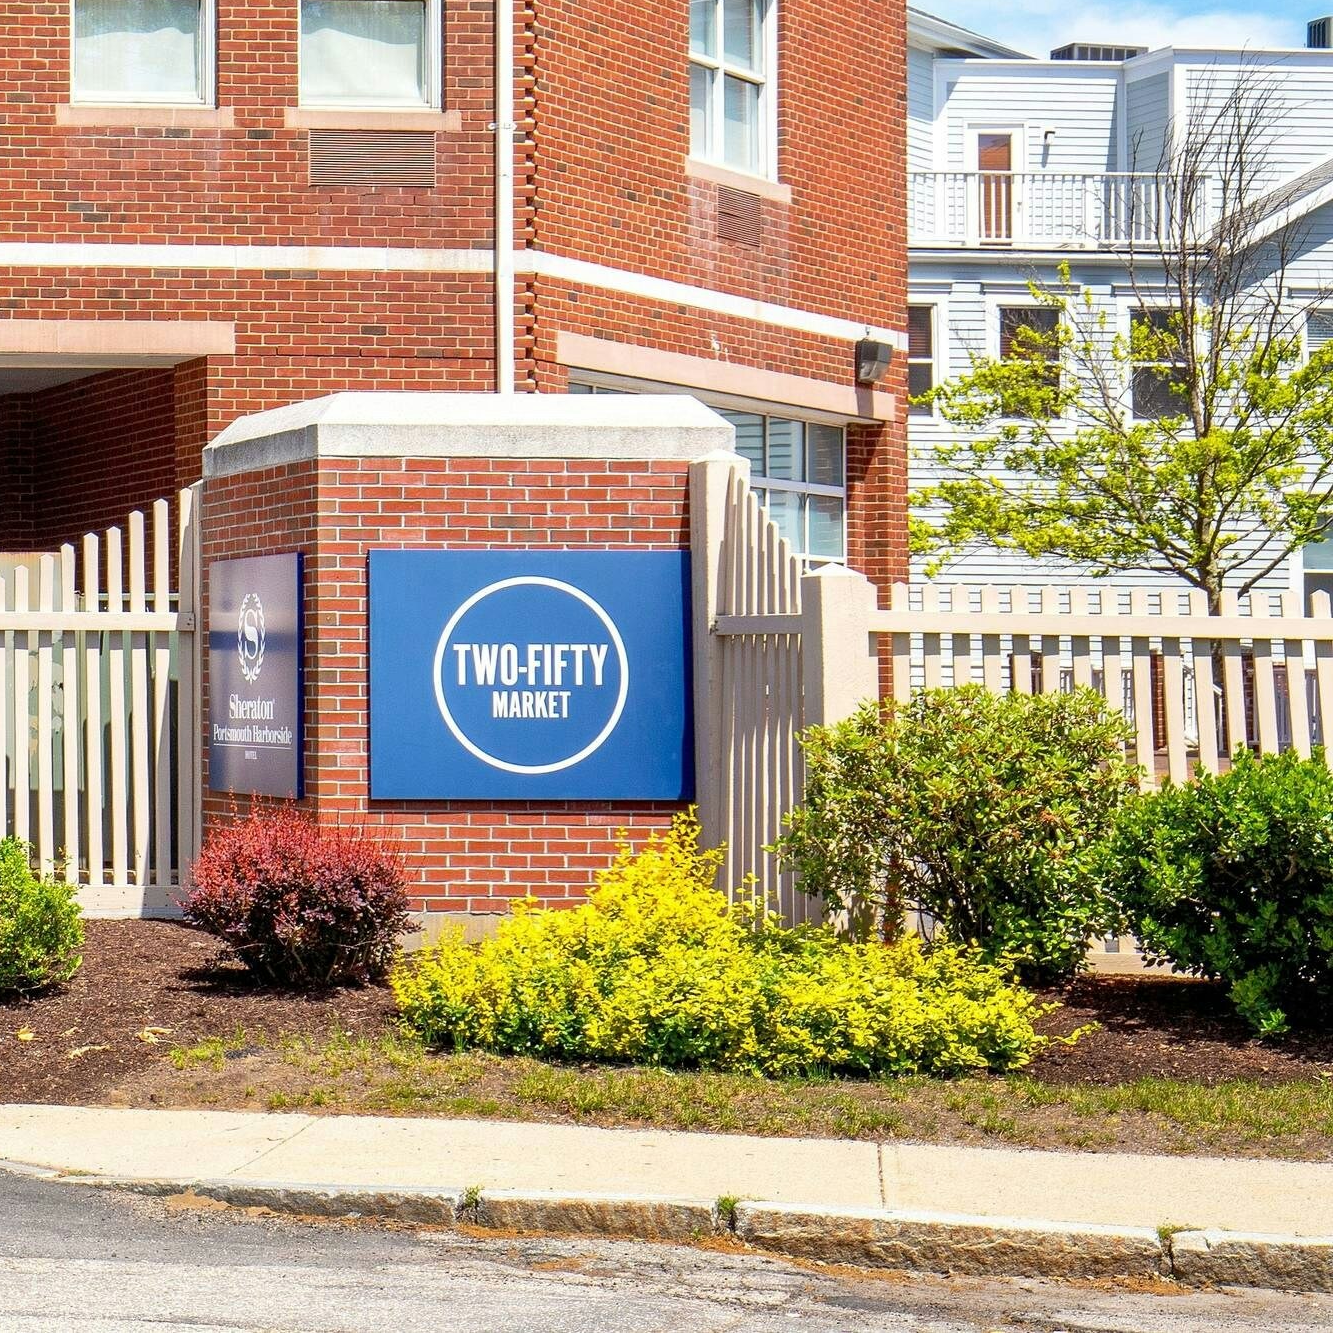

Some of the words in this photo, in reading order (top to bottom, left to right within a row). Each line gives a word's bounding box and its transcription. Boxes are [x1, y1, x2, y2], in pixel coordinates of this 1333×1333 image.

[453, 643, 609, 686] TWO-FIFTY
[229, 694, 274, 720] Sheraton
[492, 690, 572, 719] MARKET
[213, 724, 253, 742] Portsmouth
[253, 725, 292, 745] Harborside
